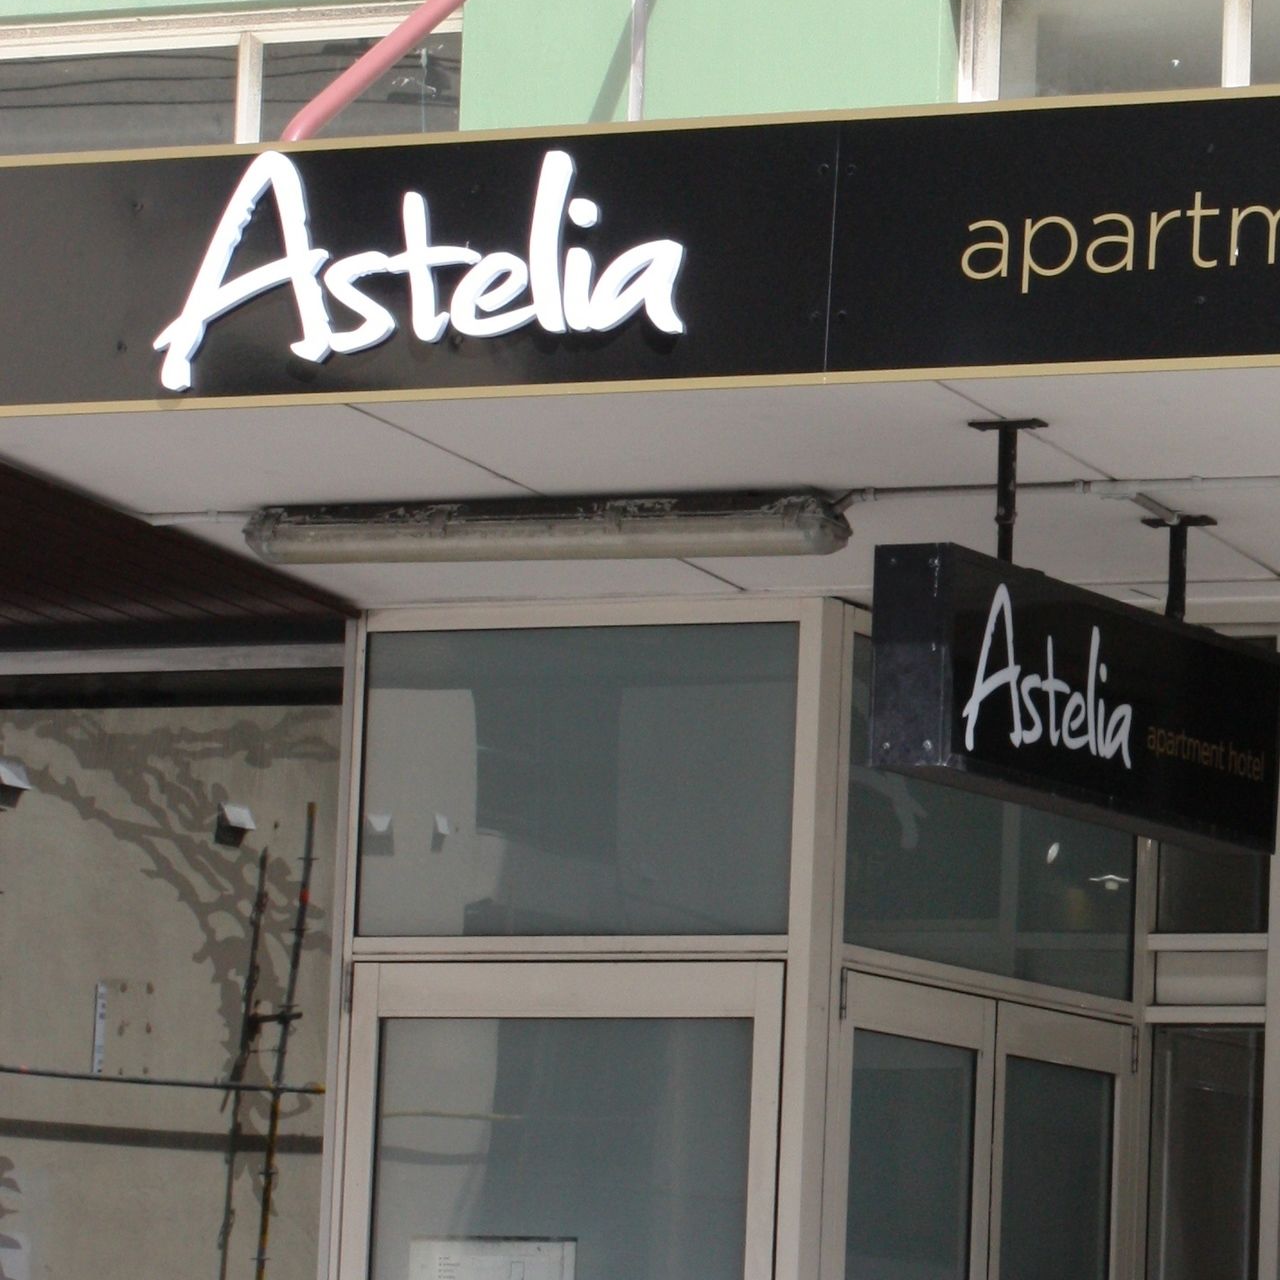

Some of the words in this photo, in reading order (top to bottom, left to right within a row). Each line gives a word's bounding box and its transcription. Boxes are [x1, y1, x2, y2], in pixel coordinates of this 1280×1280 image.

[153, 150, 687, 393] Astelia
[962, 583, 1133, 769] Astelia
[1146, 725, 1226, 772] apartment
[1228, 745, 1265, 783] hotel
